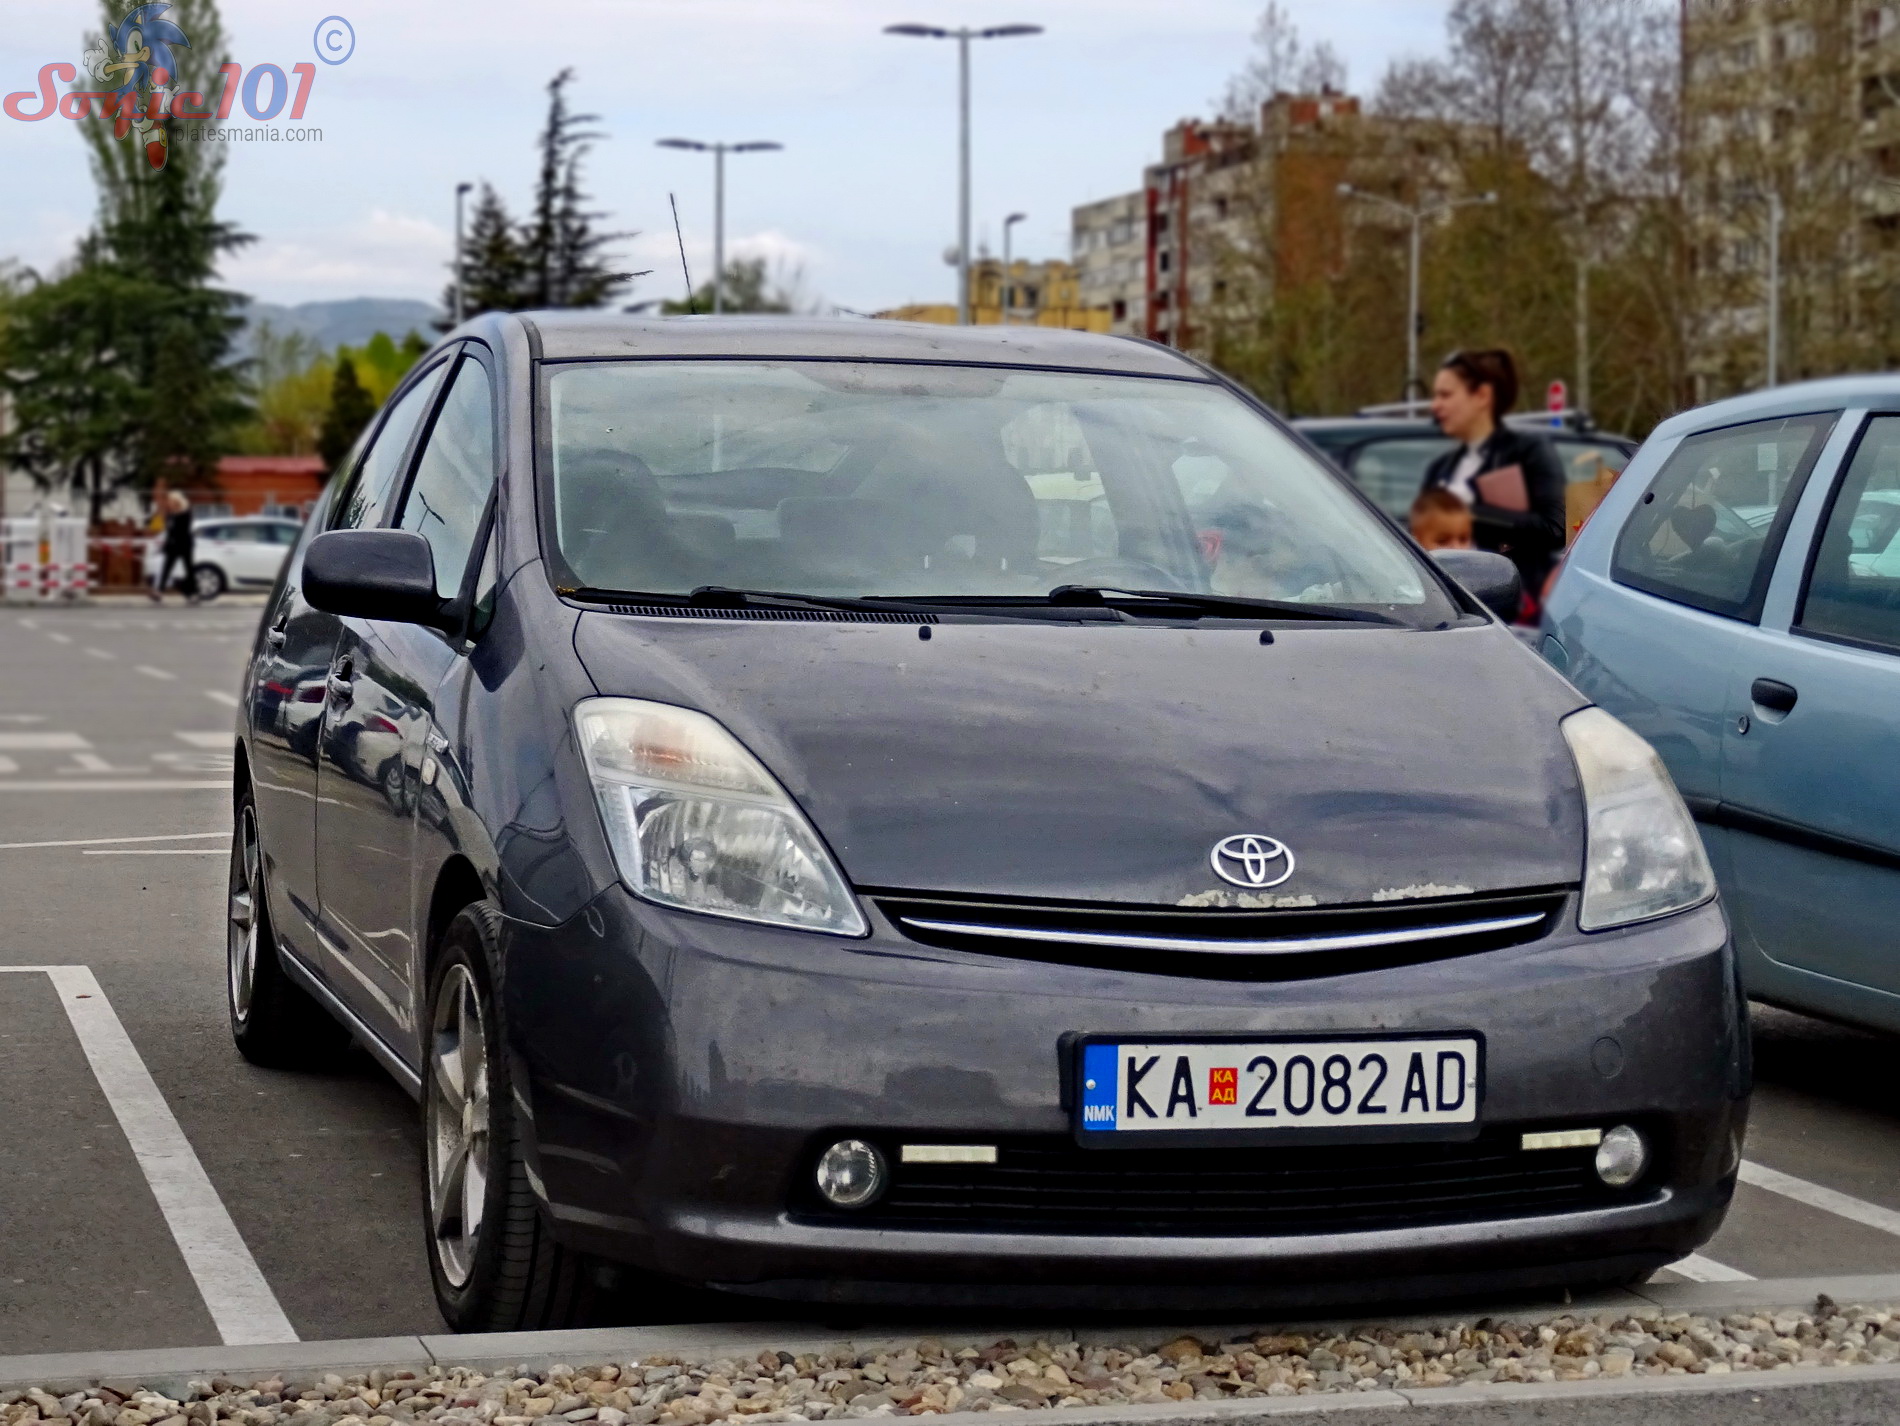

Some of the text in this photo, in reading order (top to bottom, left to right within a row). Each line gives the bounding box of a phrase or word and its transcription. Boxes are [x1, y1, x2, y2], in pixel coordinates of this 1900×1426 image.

[1126, 1051, 1466, 1118] KA 2082 AD
[1084, 1105, 1115, 1122] NMK
